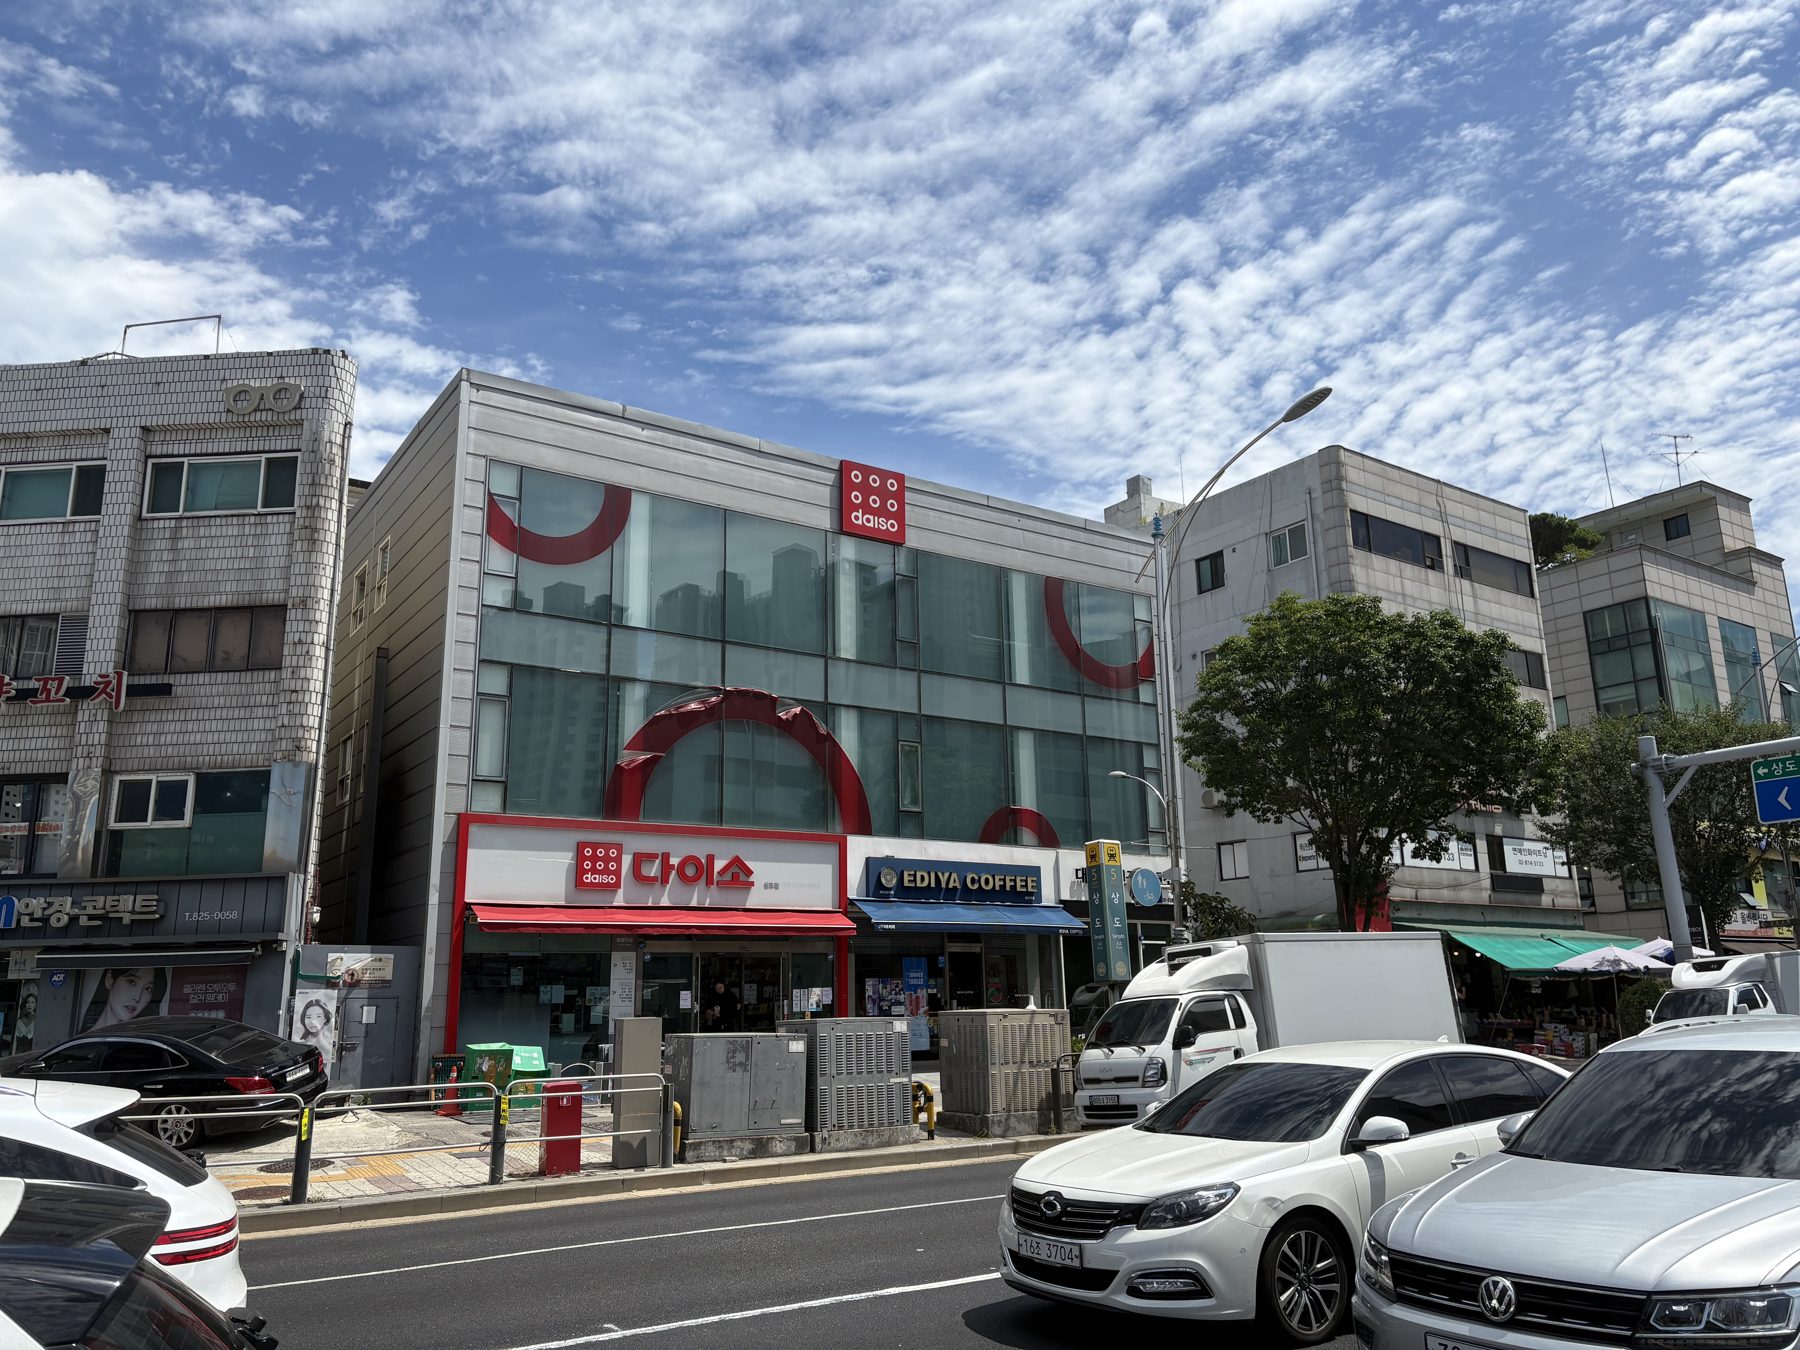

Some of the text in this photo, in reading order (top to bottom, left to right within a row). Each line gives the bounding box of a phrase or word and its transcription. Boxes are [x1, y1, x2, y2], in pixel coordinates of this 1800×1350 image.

[851, 509, 897, 532] daiso
[583, 871, 616, 884] daiso
[633, 851, 755, 887] 다이소
[1111, 868, 1117, 881] 5
[903, 869, 1038, 893] EDIYA COFFEE
[184, 910, 239, 922] T.825-0058
[1111, 892, 1122, 928] 상도
[52, 973, 66, 982] ADT
[1024, 1239, 1075, 1263] 16조 3704
